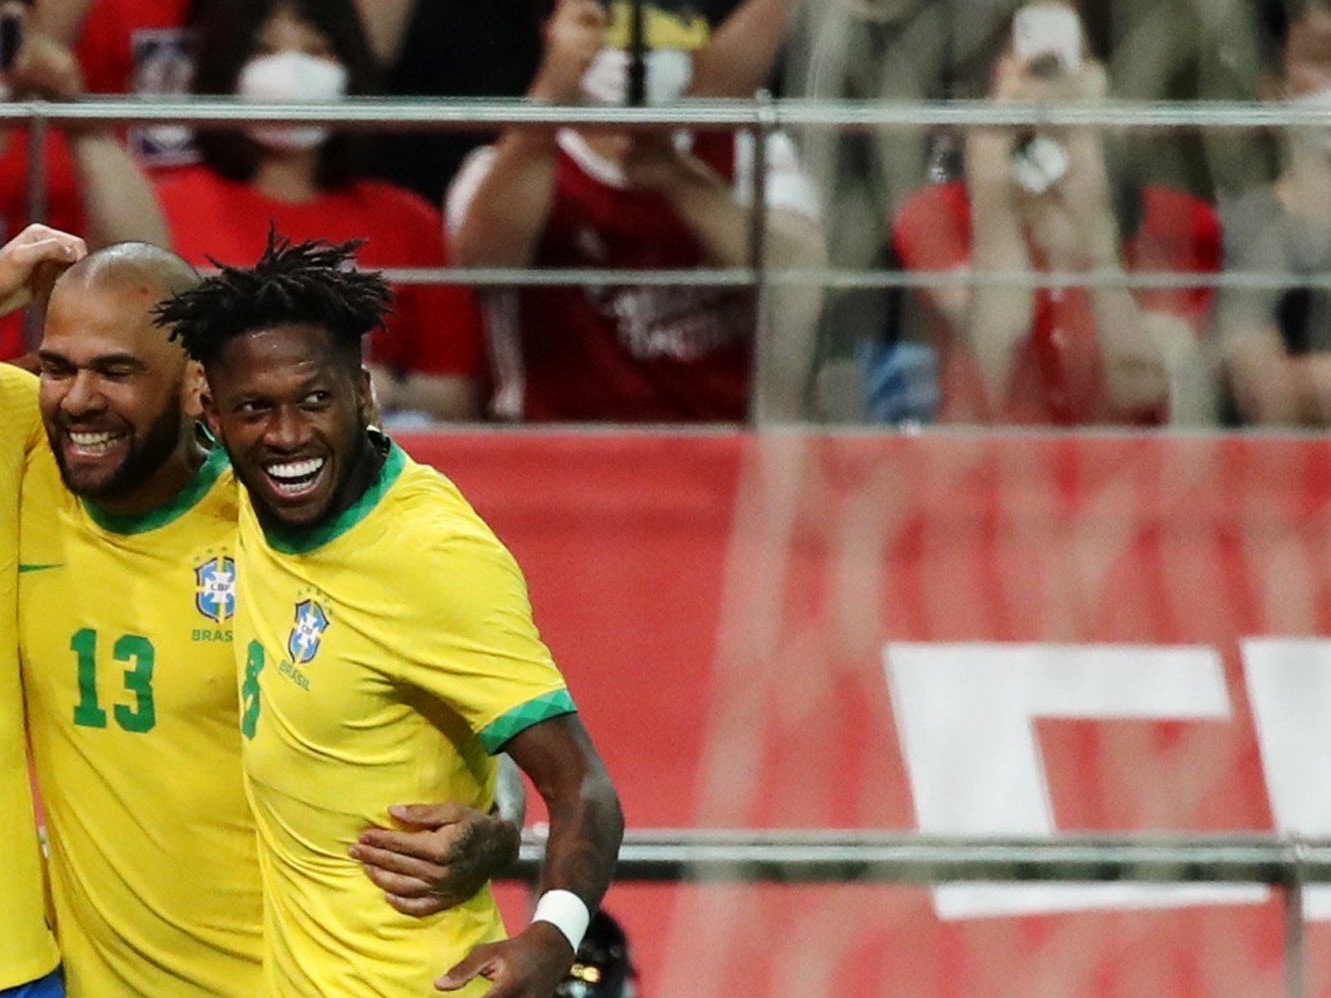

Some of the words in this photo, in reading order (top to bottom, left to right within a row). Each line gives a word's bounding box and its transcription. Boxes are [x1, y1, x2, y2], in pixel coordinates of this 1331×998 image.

[70, 627, 156, 734] 13
[241, 639, 265, 741] 8
[279, 660, 310, 692] BRASIL
